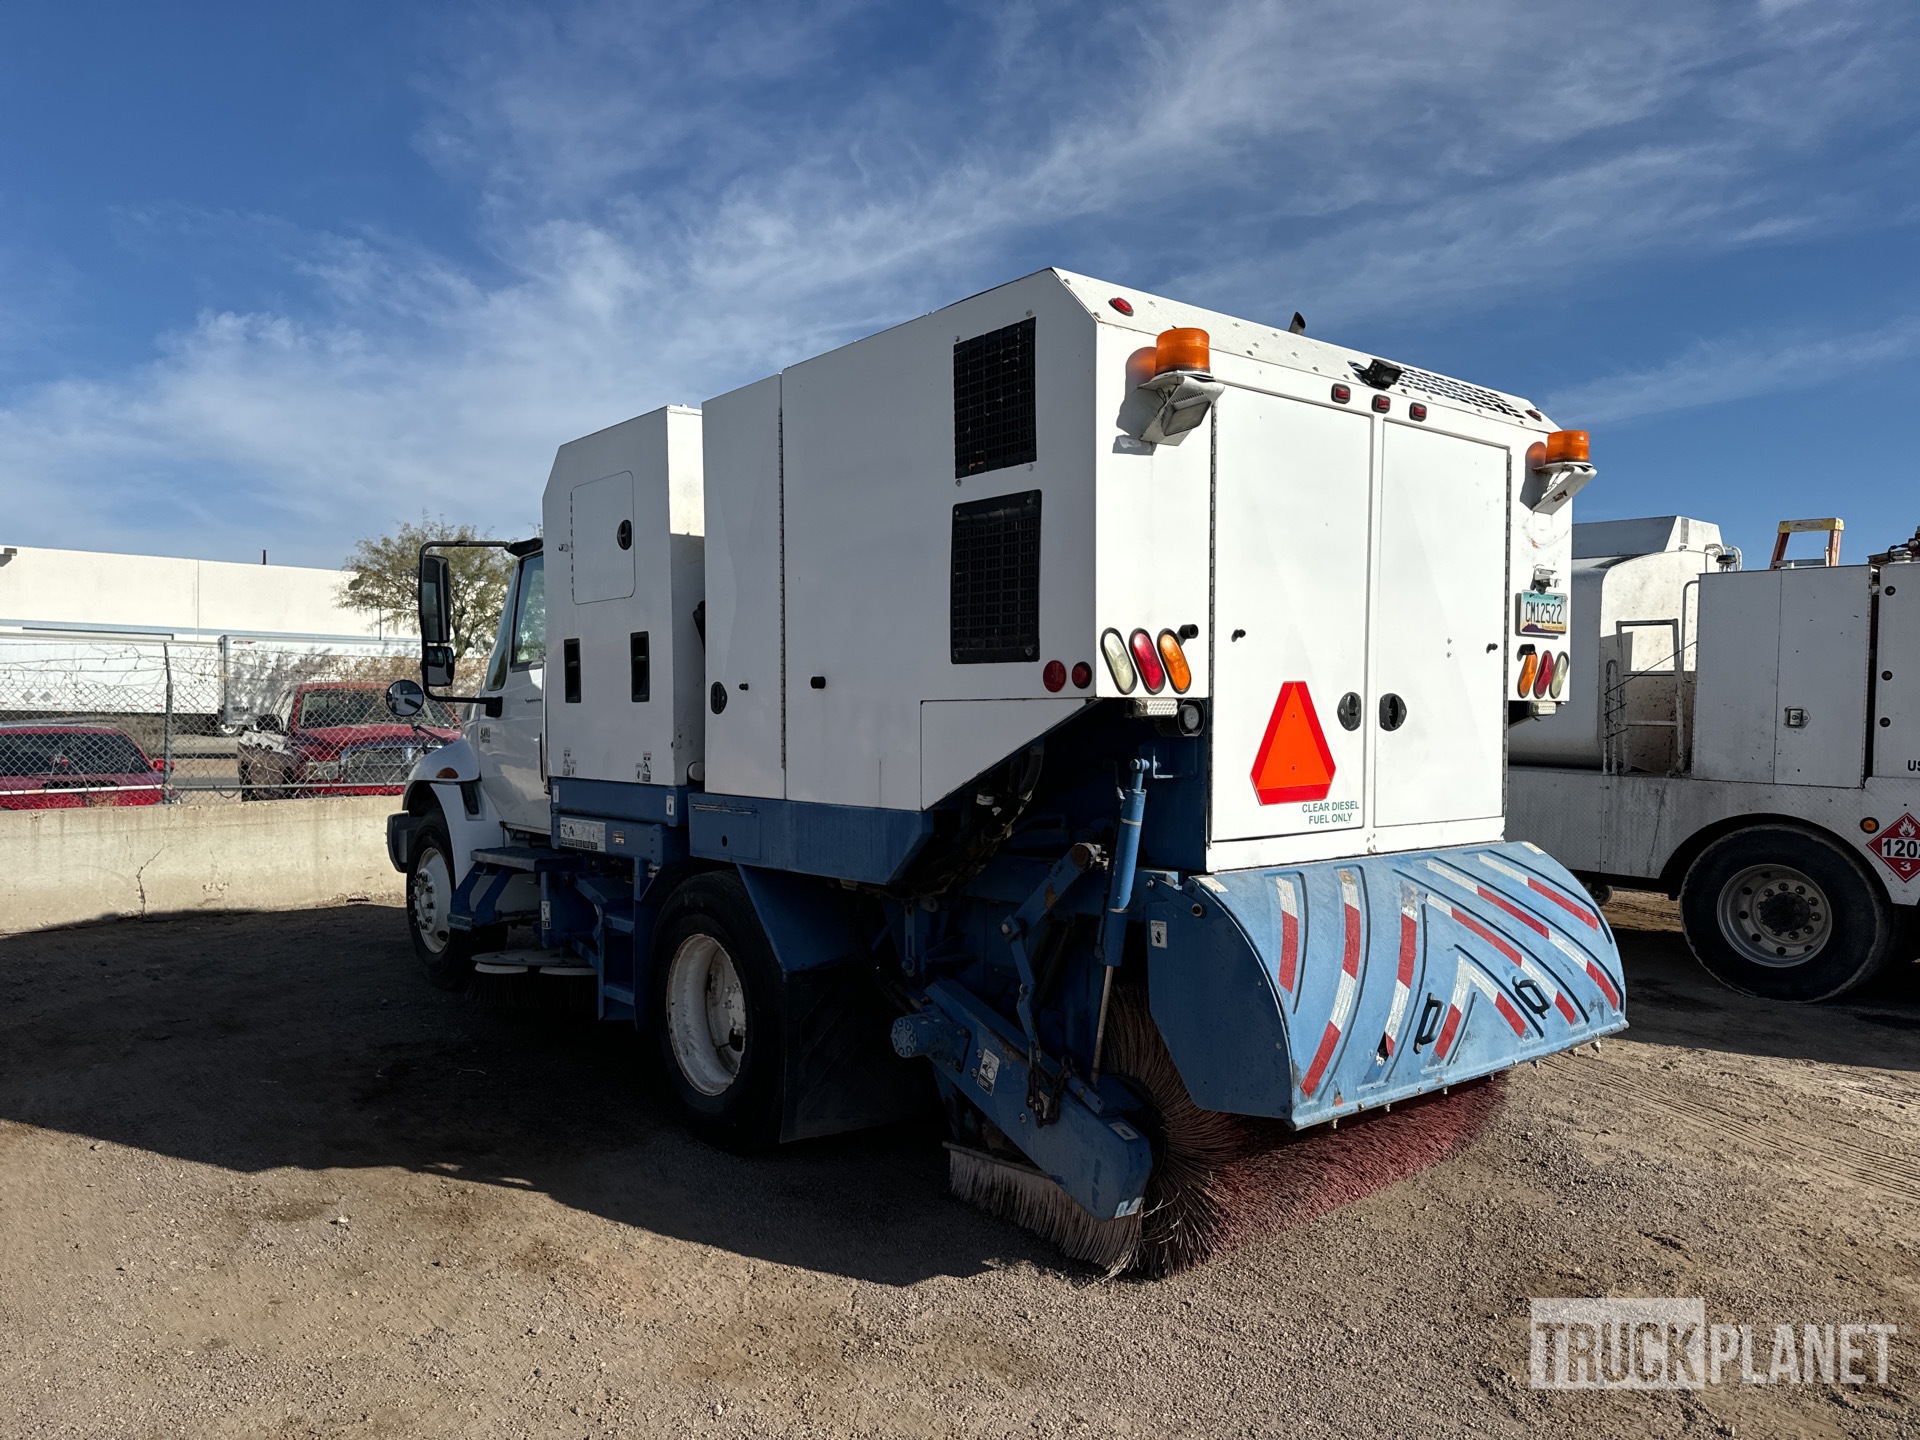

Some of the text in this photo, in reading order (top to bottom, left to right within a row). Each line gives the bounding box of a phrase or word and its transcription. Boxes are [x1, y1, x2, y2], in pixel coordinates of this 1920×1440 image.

[1526, 601, 1563, 624] CM12522
[1302, 801, 1360, 813] CLEAR DIESEL
[1309, 813, 1353, 825] FUEL ONLY
[1883, 838, 1920, 859] 120
[1899, 861, 1912, 872] 3
